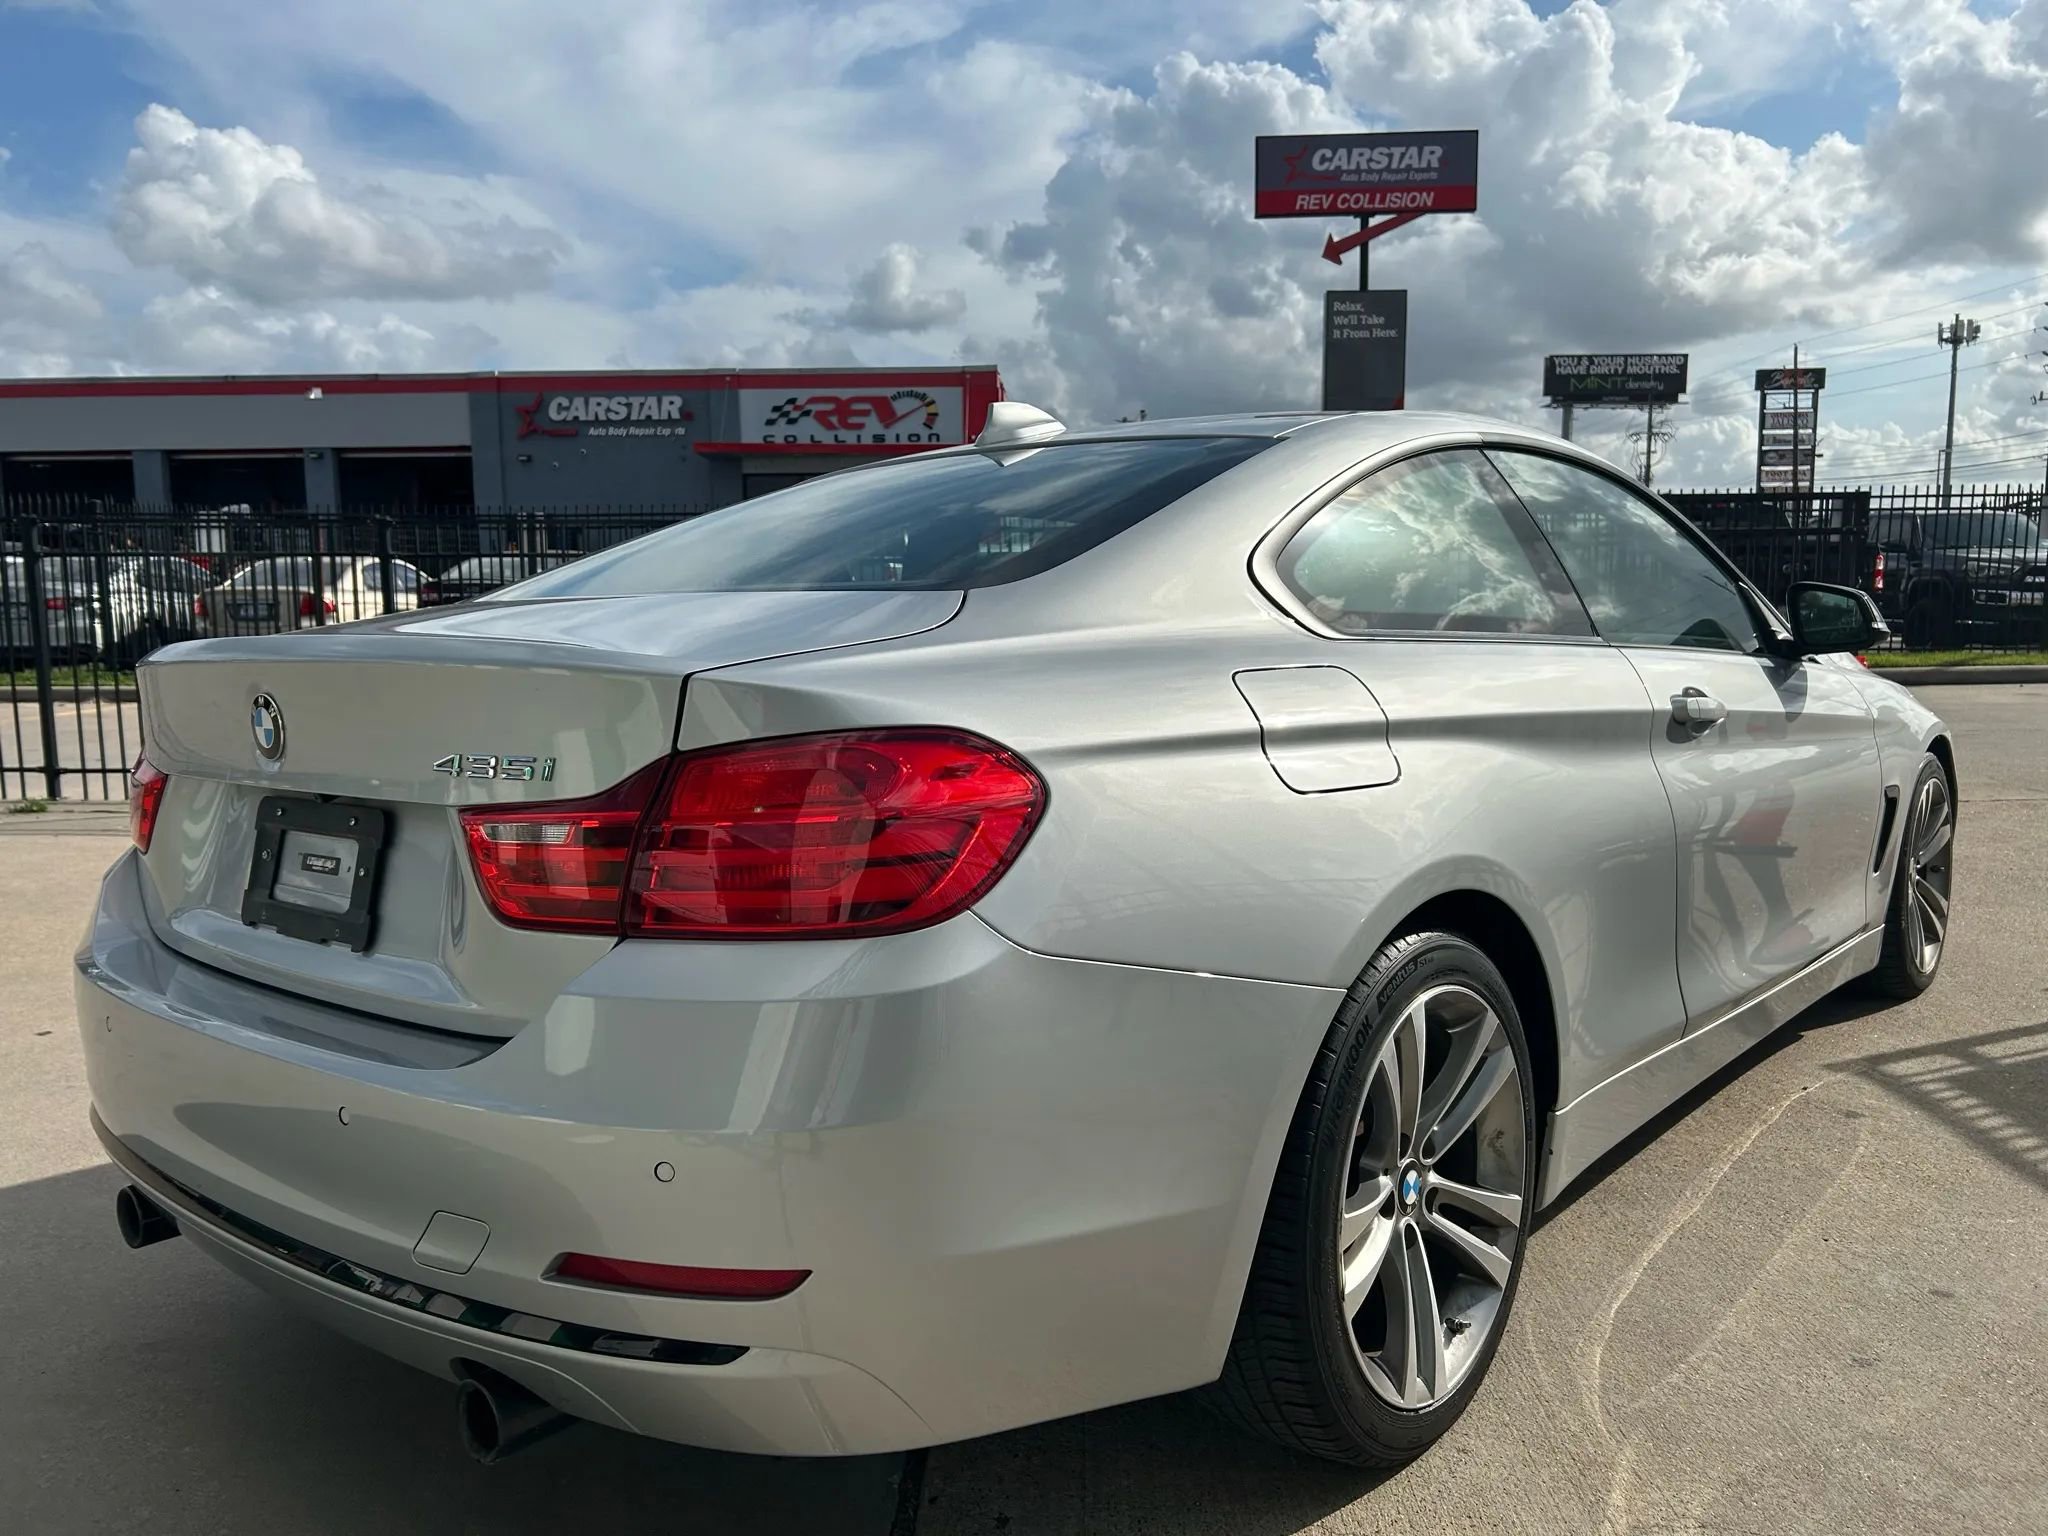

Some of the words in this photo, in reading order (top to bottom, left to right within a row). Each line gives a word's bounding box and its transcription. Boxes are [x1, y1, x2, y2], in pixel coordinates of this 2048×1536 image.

[1312, 146, 1443, 171] CARSTAR
[1340, 172, 1359, 182] Auto
[1360, 172, 1379, 183] Body
[1380, 171, 1407, 182] Repair
[1409, 171, 1438, 182] Experts
[1295, 193, 1333, 210] REV
[1336, 191, 1434, 209] COLLISION
[1333, 301, 1364, 312] Relax,
[1333, 315, 1358, 325] We'll
[1360, 314, 1385, 325] Take
[1332, 329, 1341, 338] It
[1343, 329, 1370, 338] From
[1553, 356, 1578, 366] YOU
[1580, 356, 1589, 366] &
[1592, 356, 1624, 366] YOUR
[1627, 355, 1684, 365] HUSBAND
[1556, 365, 1588, 375] HAVE
[1590, 365, 1624, 375] DIRTY
[1570, 376, 1626, 392] MINT
[548, 395, 683, 421] CARSTAR
[800, 396, 898, 431] REV
[588, 426, 607, 436] Auto
[608, 426, 628, 438] Body
[629, 426, 654, 438] Repair
[763, 432, 940, 444] COLLISION
[432, 753, 557, 782] 435i
